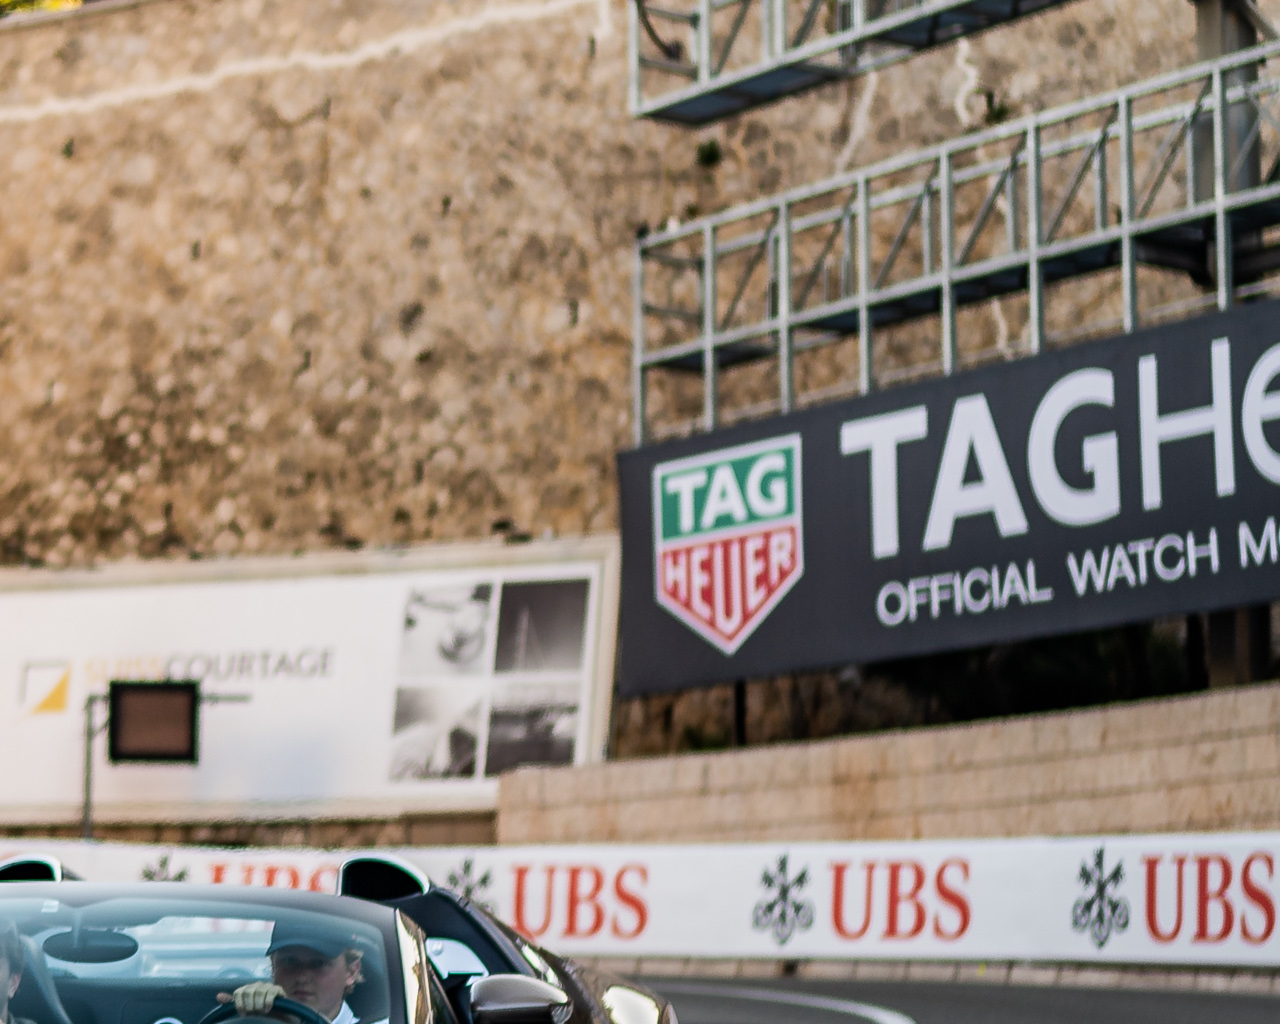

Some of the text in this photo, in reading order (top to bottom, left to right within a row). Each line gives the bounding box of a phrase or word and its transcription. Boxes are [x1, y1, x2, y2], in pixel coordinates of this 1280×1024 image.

[665, 452, 787, 534] TAG
[664, 530, 794, 635] HEUER
[876, 515, 1280, 628] OFFICIAL WATCH M
[510, 861, 649, 941] UBS
[830, 856, 972, 941] UBS
[1140, 851, 1276, 946] UBS
